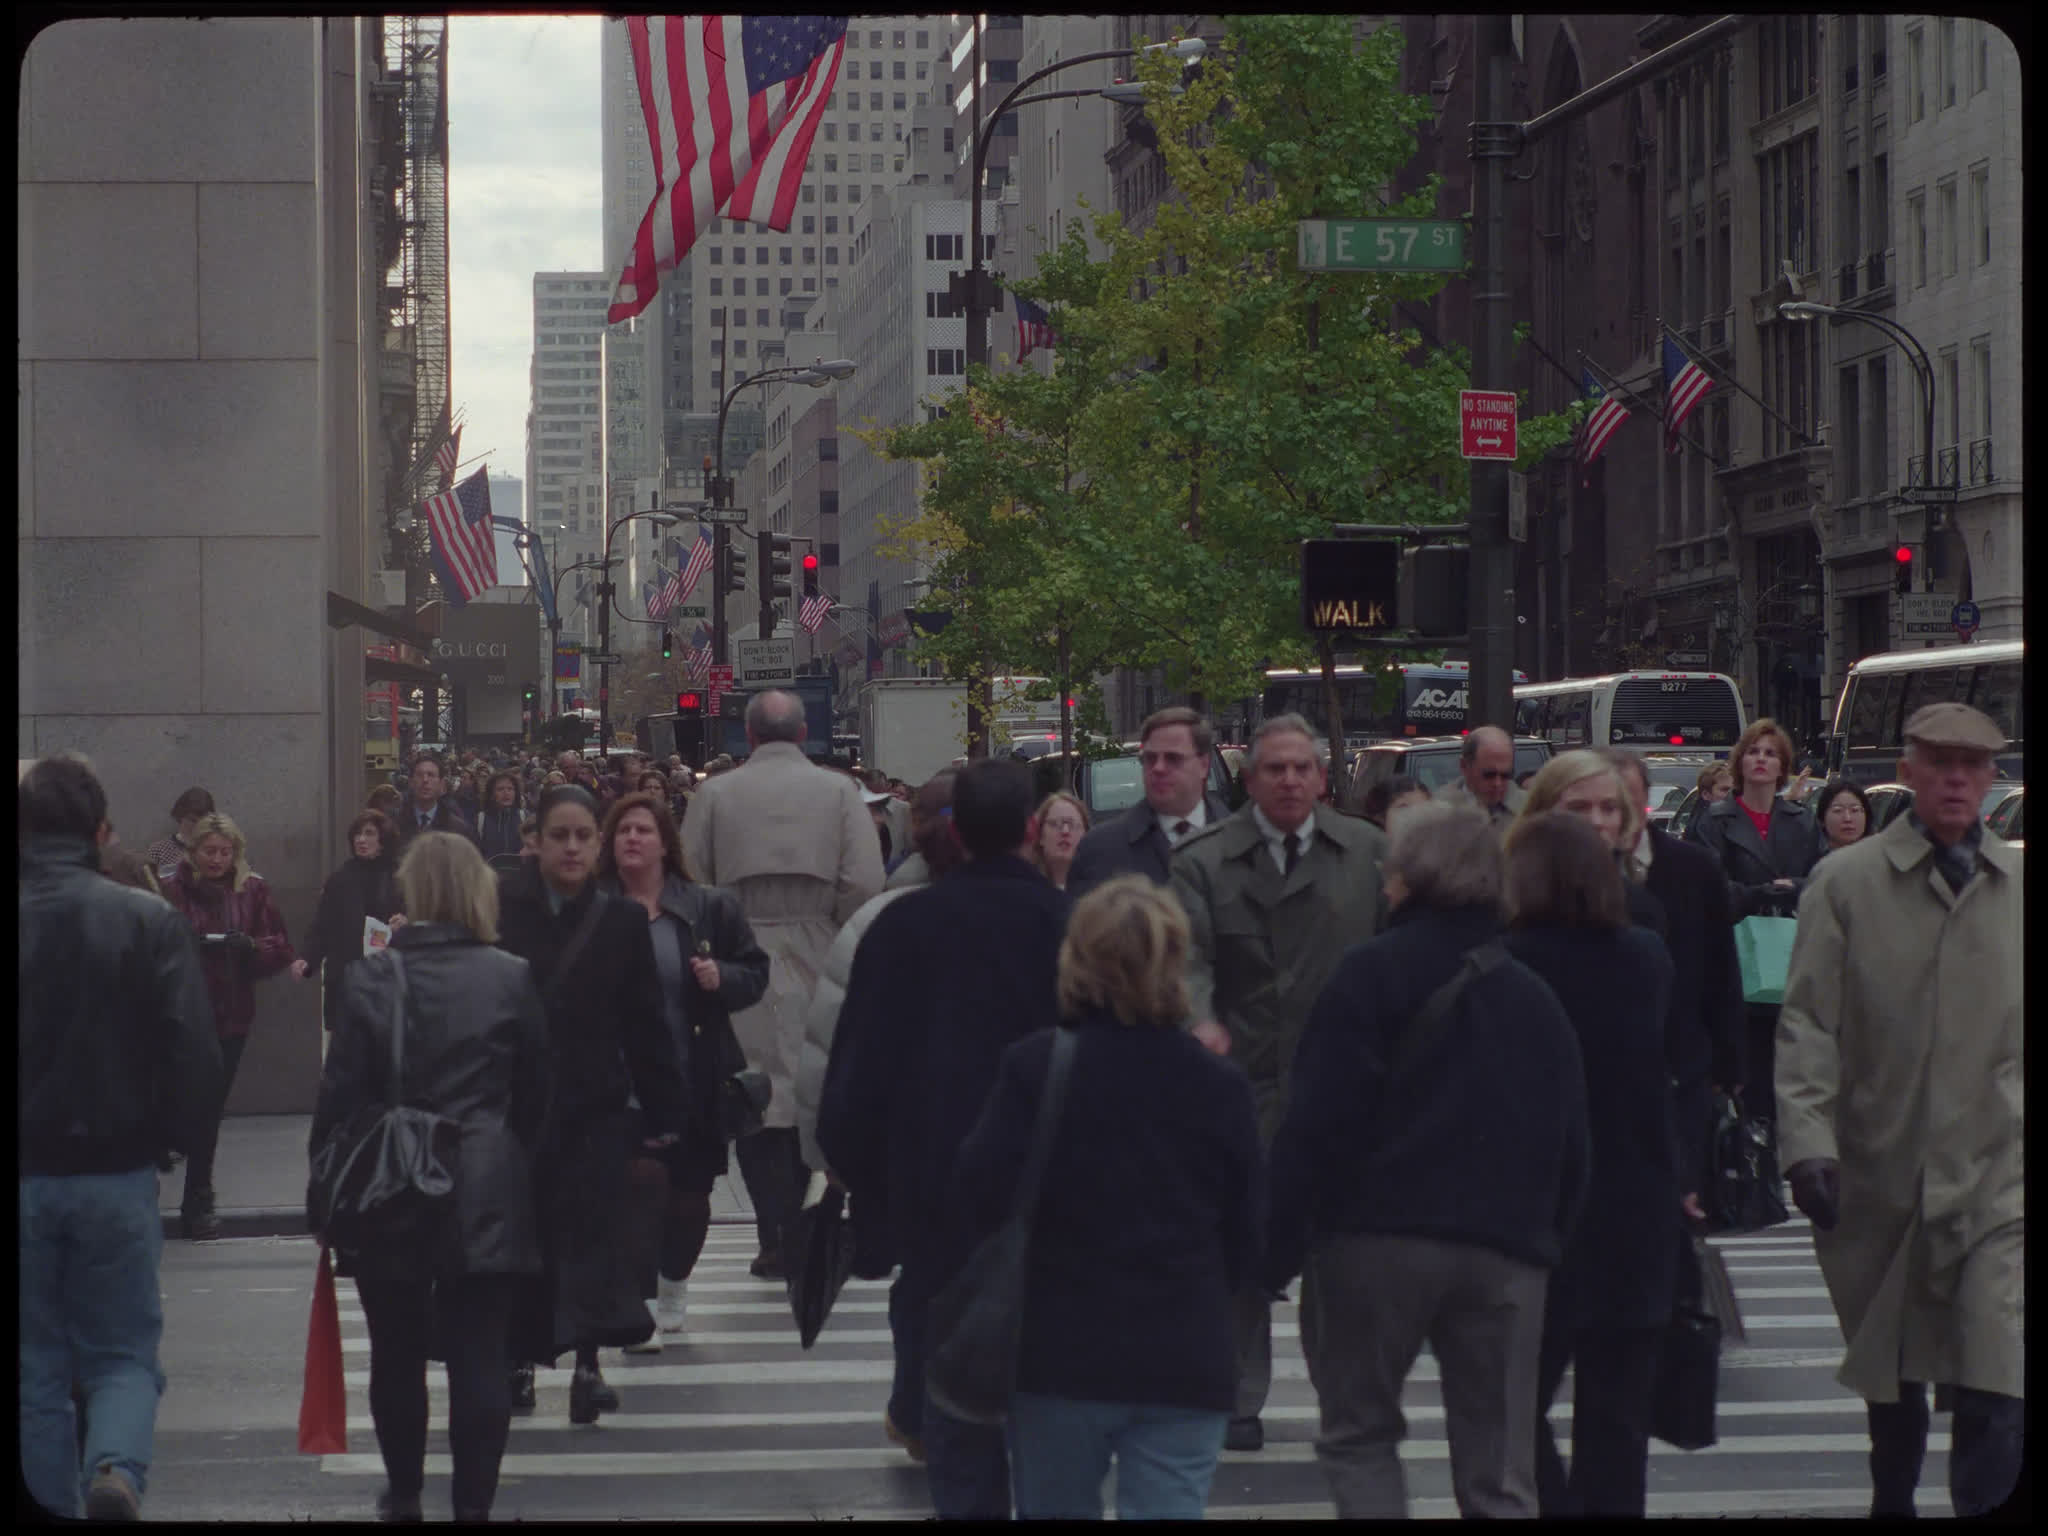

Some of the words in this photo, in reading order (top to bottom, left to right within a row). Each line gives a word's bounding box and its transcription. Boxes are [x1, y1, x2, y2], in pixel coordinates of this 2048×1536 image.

[1335, 226, 1355, 262] E
[1376, 226, 1419, 263] 57
[1432, 226, 1457, 247] ST
[1463, 399, 1474, 412] NO
[1477, 399, 1514, 414] STANDING
[1470, 417, 1509, 432] ANYTIME
[1314, 599, 1386, 627] WALK
[439, 643, 506, 657] GUCCI
[1661, 681, 1689, 692] 8277
